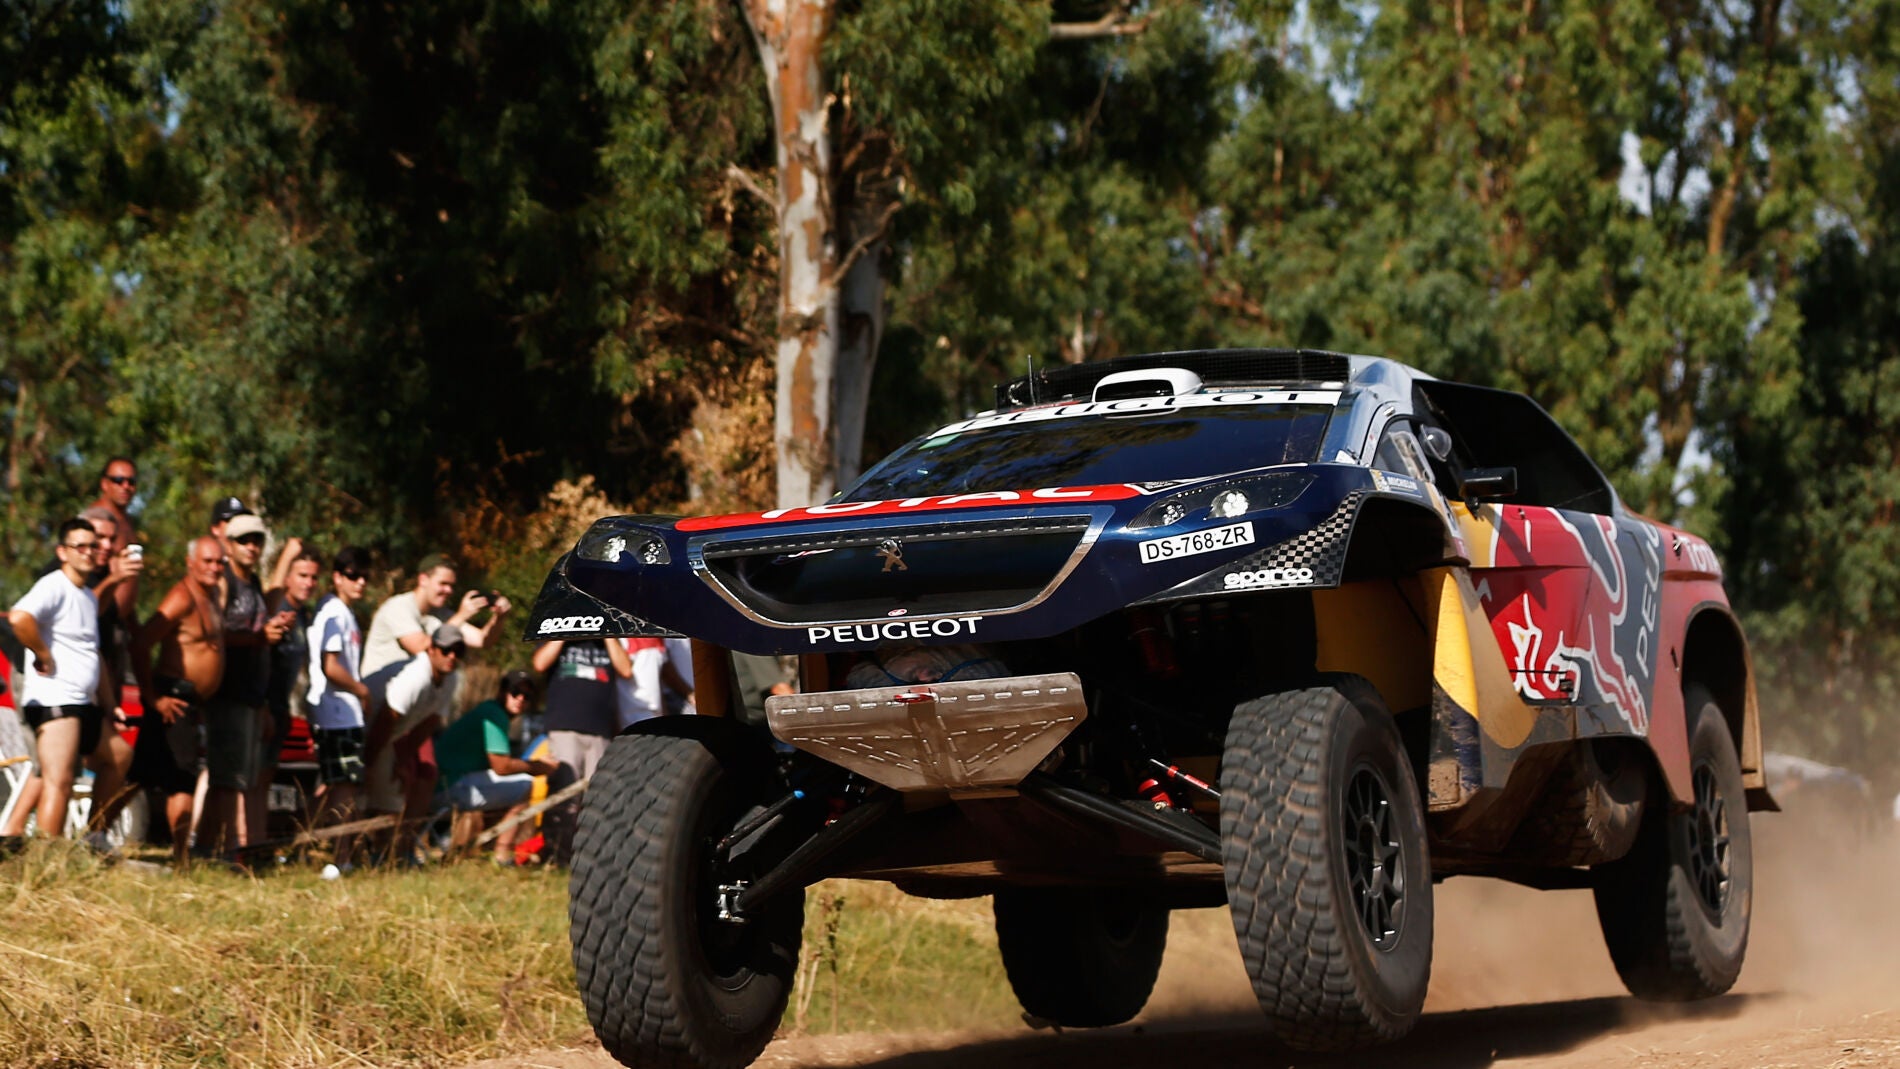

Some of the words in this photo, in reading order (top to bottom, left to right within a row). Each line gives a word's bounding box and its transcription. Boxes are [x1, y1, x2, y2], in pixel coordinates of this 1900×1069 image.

[961, 393, 1309, 430] PEUGEOT
[1146, 526, 1248, 561] DS-768-ZR
[1223, 567, 1313, 590] sparco
[537, 616, 604, 634] sparco
[807, 616, 983, 645] PEUGEOT
